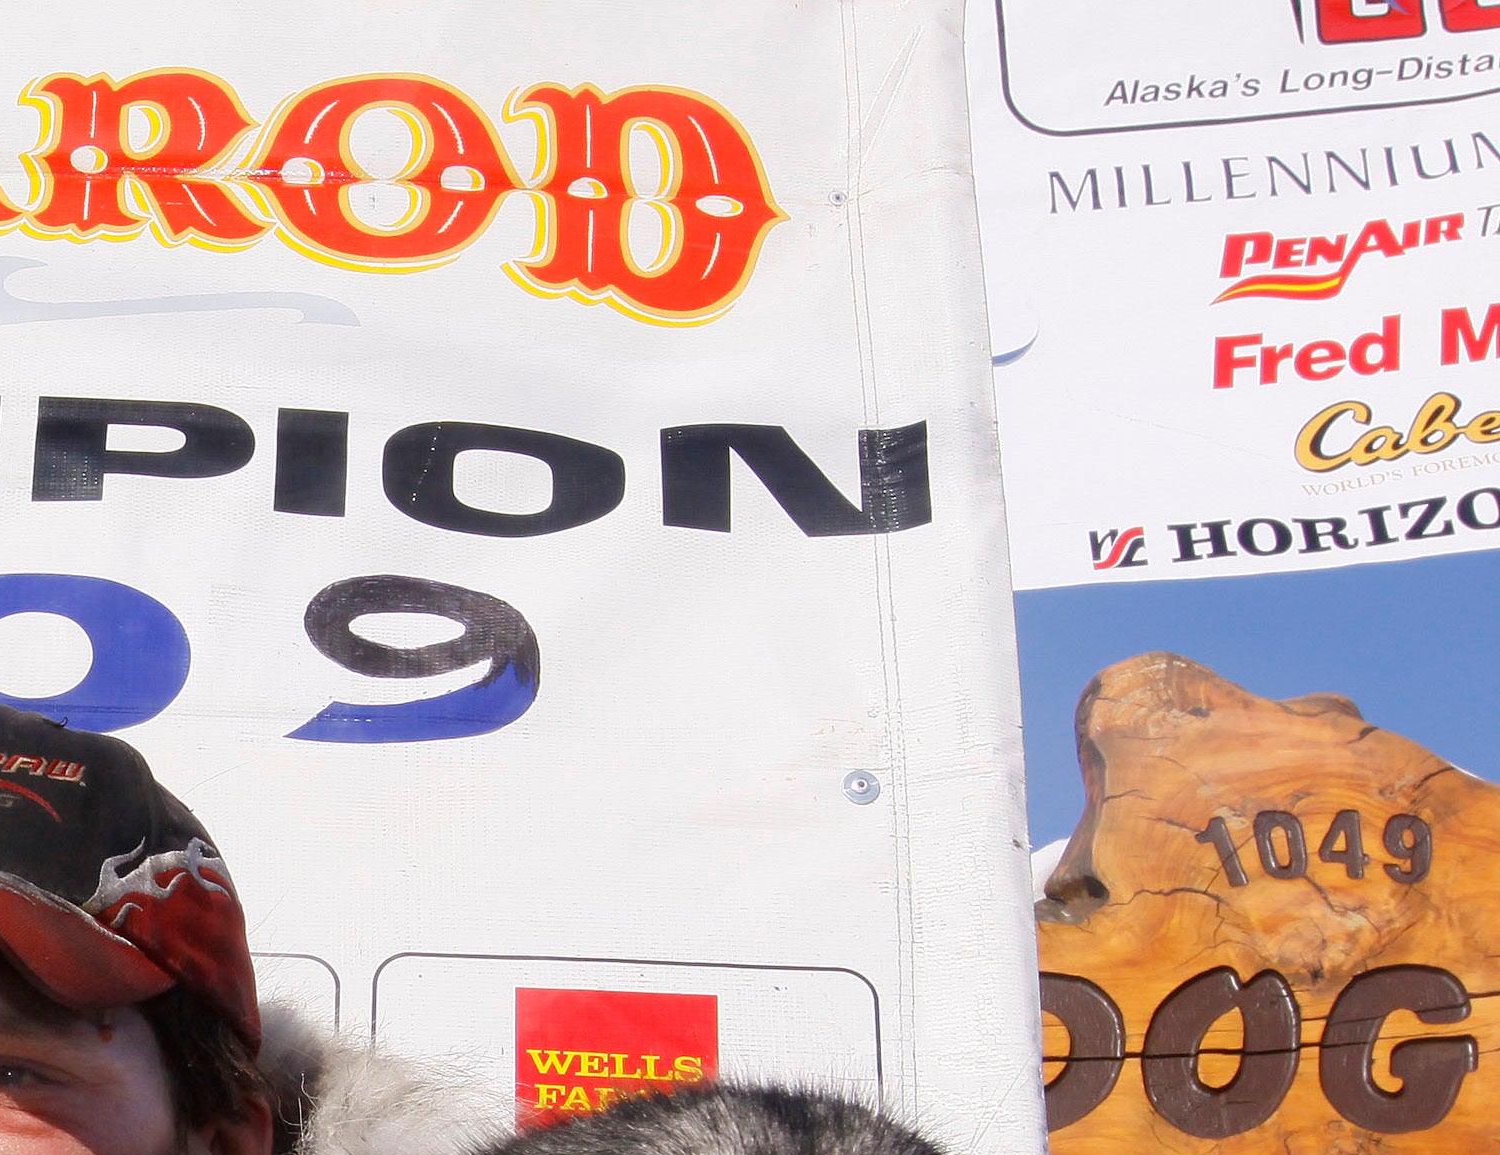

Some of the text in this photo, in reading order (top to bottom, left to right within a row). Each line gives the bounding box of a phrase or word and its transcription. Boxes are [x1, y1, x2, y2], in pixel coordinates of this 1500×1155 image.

[1104, 52, 1500, 106] Alaska's Long-Dista
[1477, 203, 1500, 238] T
[1213, 314, 1401, 390] Fred
[1301, 470, 1402, 497] WORLD'S
[1167, 488, 1500, 563] HORIZO
[1195, 809, 1433, 888] 1049
[526, 1049, 703, 1083] WELLS
